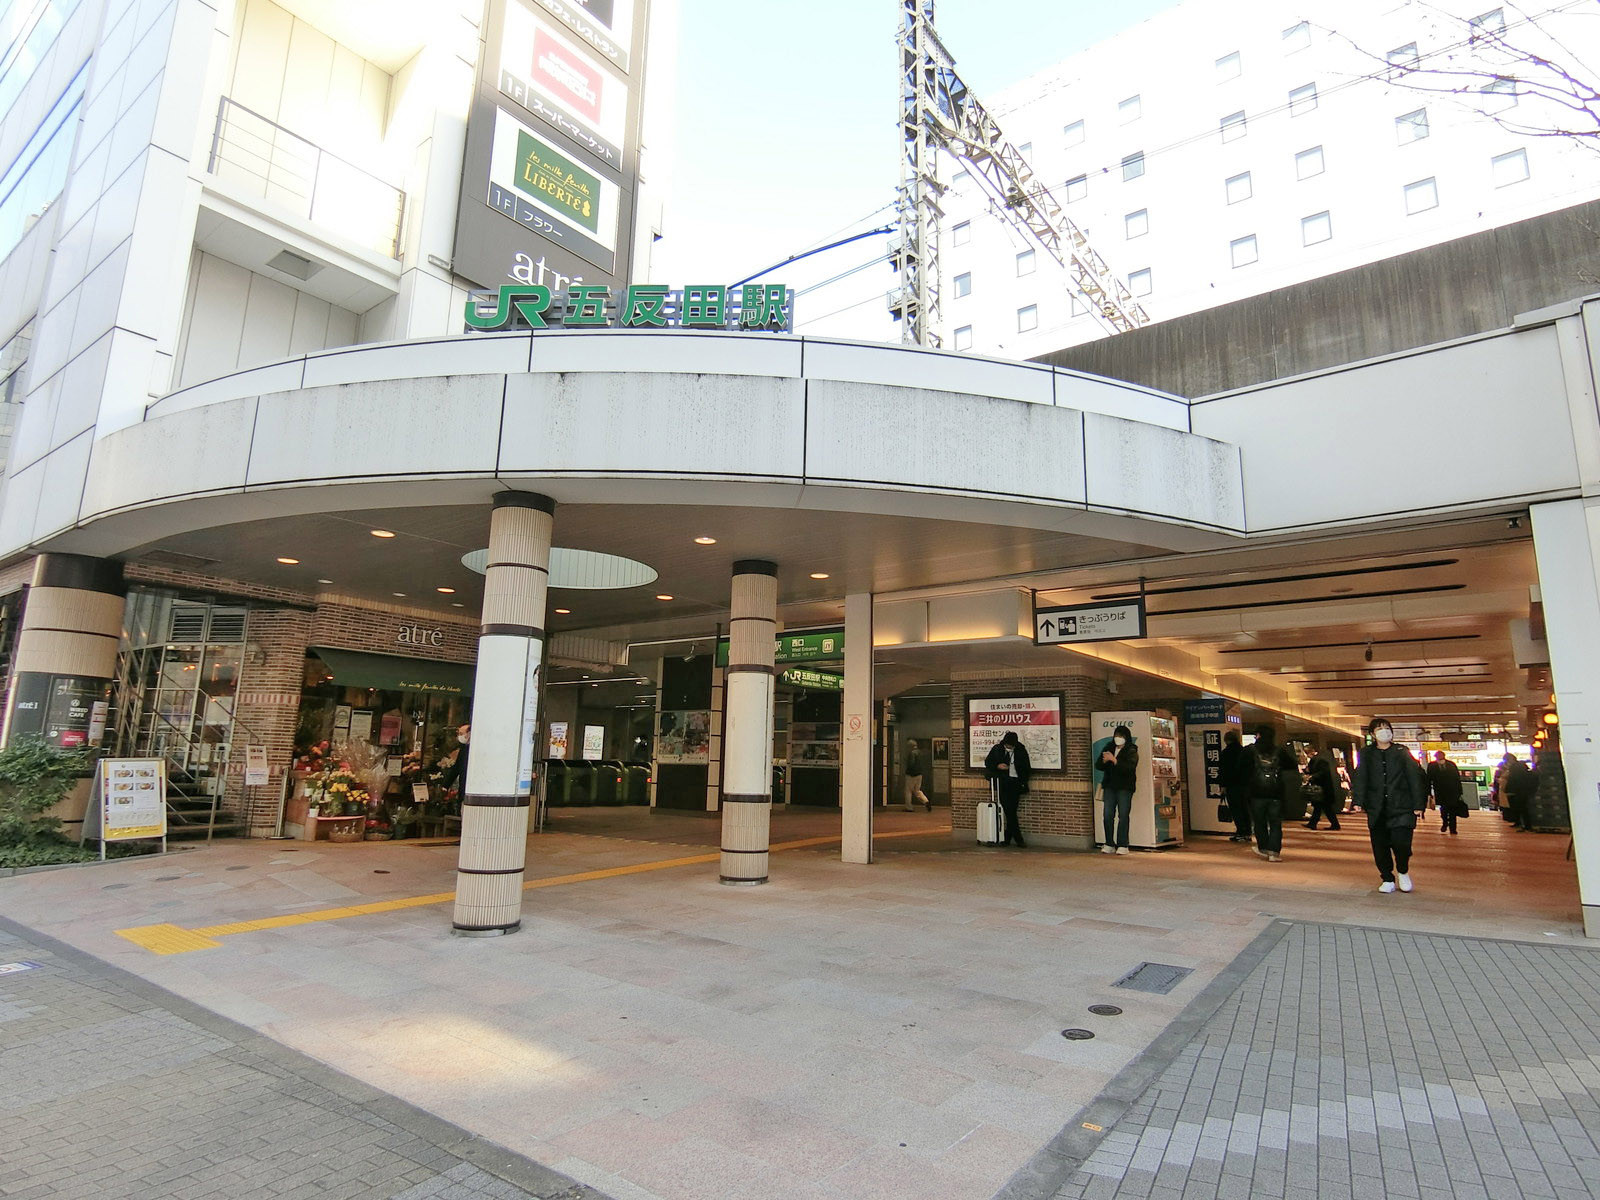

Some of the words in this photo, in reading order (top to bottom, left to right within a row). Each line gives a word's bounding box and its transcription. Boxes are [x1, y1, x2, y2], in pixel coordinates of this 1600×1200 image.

[507, 77, 523, 98] 1F
[533, 98, 613, 159] スーパーマーケット
[496, 190, 511, 210] 1F
[524, 210, 563, 237] フラワー
[1079, 611, 1126, 624] きっぷうりば
[397, 624, 443, 647] atré
[791, 639, 804, 647] 西口
[979, 714, 1031, 724] 三井のリハウス
